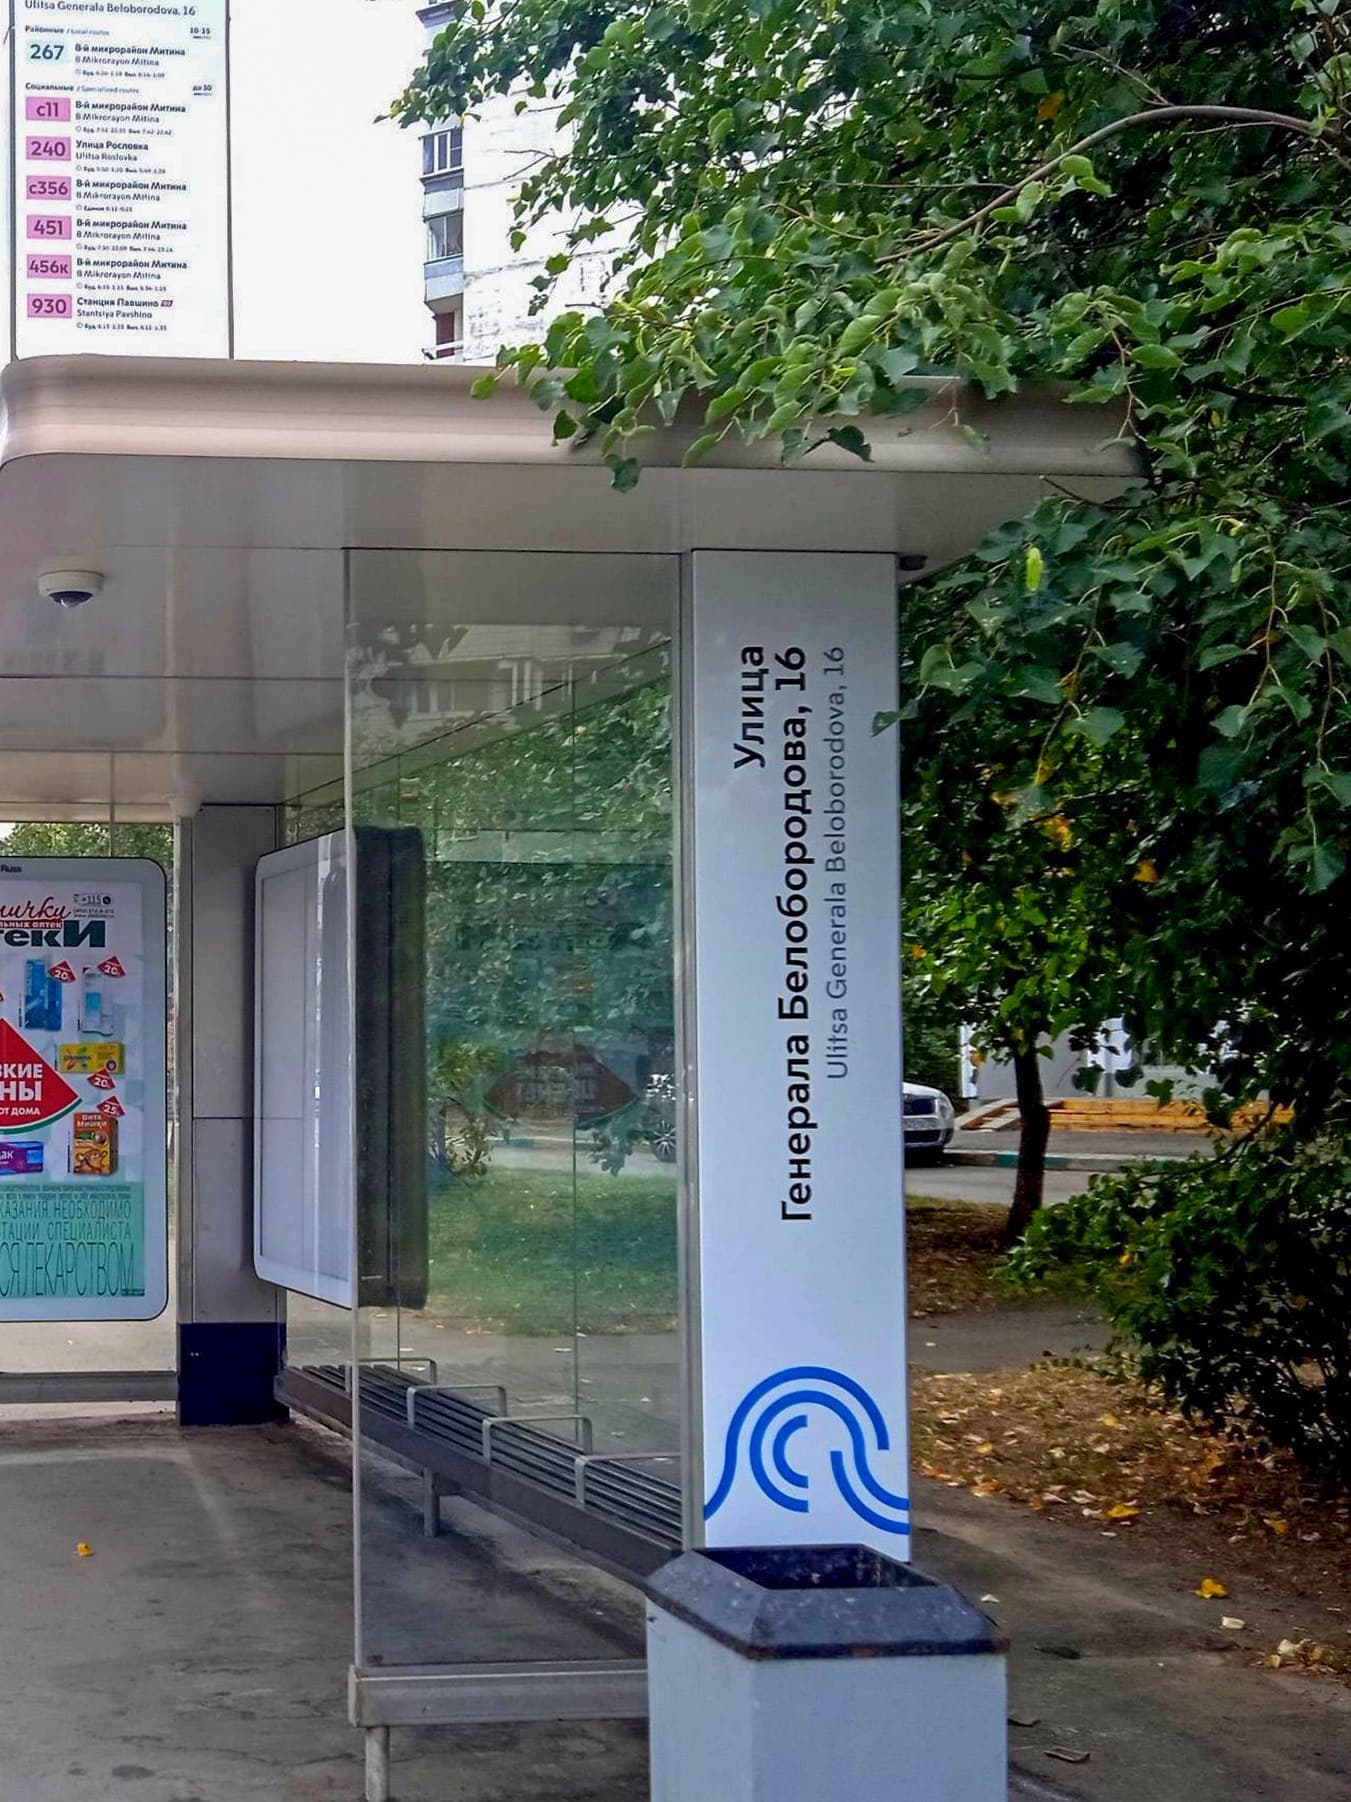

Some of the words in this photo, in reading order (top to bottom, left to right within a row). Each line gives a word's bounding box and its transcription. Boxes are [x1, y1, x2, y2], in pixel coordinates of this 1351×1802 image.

[25, 0, 55, 10] Ulitsa
[57, 3, 104, 13] Generala
[183, 6, 196, 16] 16
[30, 44, 64, 60] 267
[92, 45, 148, 56] микрорайон
[150, 47, 186, 56] Митина
[82, 57, 130, 67] Mikrorayon
[132, 58, 160, 66] Mitina
[25, 83, 74, 92] Социальные
[92, 102, 148, 112] микрорайон
[150, 104, 186, 113] Митина
[82, 114, 130, 123] Mikrorayon
[132, 115, 160, 123] Mitina
[31, 141, 66, 156] 240
[76, 140, 104, 150] Улица
[106, 141, 148, 150] Рословка
[76, 152, 100, 160] Ulitsa
[102, 153, 138, 162] Roslovka
[92, 180, 149, 191] микрорайон
[151, 182, 186, 191] Митина
[83, 192, 131, 202] Mikrorayon
[132, 194, 160, 202] Mitina
[33, 220, 64, 236] 451
[92, 220, 149, 230] микрорайон
[151, 222, 187, 230] Митина
[83, 231, 132, 242] Mikrorayon
[132, 232, 161, 240] Mitina
[29, 260, 68, 274] 456к
[93, 259, 150, 270] микрорайон
[152, 260, 187, 270] Митина
[84, 270, 132, 281] Mikrorayon
[132, 272, 161, 280] Mitina
[32, 298, 66, 314] 930
[77, 297, 116, 308] Станция
[116, 298, 159, 308] Павшино
[77, 310, 114, 320] Stantsiya
[116, 310, 152, 319] Pavshino
[824, 646, 844, 676] 16
[775, 646, 806, 691] 16
[734, 645, 769, 769] Улица
[824, 685, 847, 872] Beloborodova,
[0, 864, 22, 872] Russ
[776, 706, 815, 1019] Белобородова,
[32, 921, 62, 929] аптек
[824, 882, 847, 999] Generala
[826, 1008, 848, 1079] Ulitsa
[12, 1107, 40, 1116] ДОМА
[780, 1034, 818, 1220] Генерала
[54, 1200, 132, 1220] НЕОБХОДИМО
[48, 1222, 132, 1241] СПЕЦИАЛИСТА
